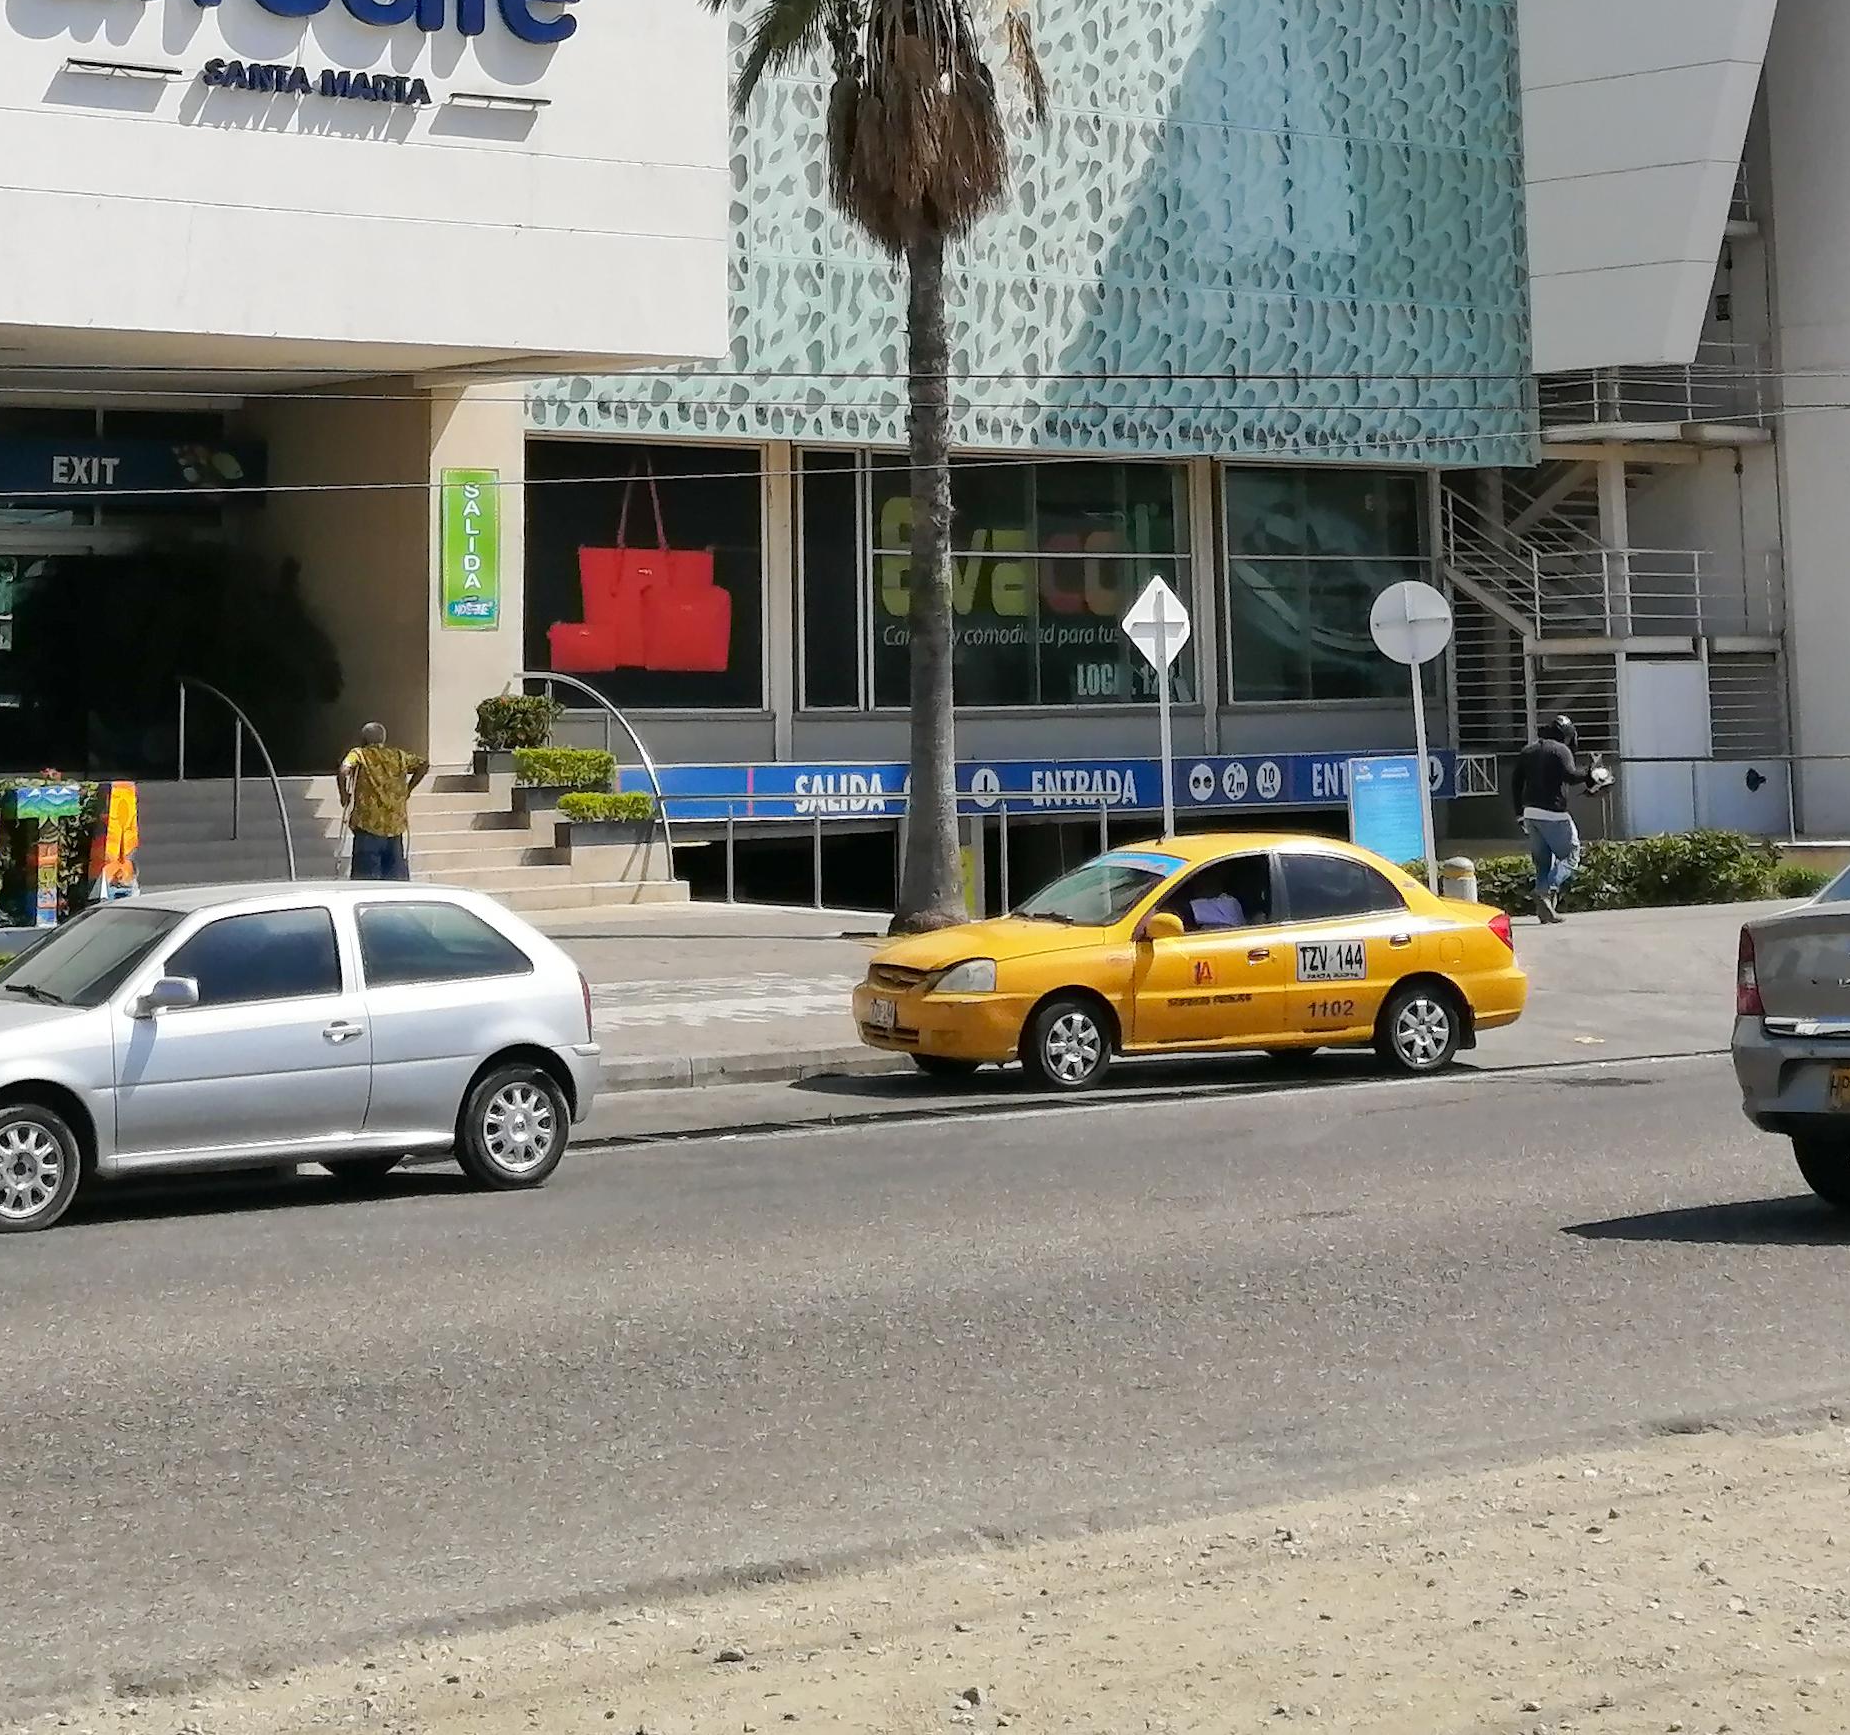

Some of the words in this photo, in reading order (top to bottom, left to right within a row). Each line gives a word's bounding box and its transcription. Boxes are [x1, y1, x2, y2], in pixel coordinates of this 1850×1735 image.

[202, 57, 313, 95] SANTA
[320, 69, 433, 105] MARTA
[52, 454, 121, 486] EXIT
[461, 482, 482, 590] SALIDA
[795, 772, 886, 813] SALIDA
[1031, 769, 1137, 807] ENTRADA
[1307, 1000, 1355, 1018] 1102
